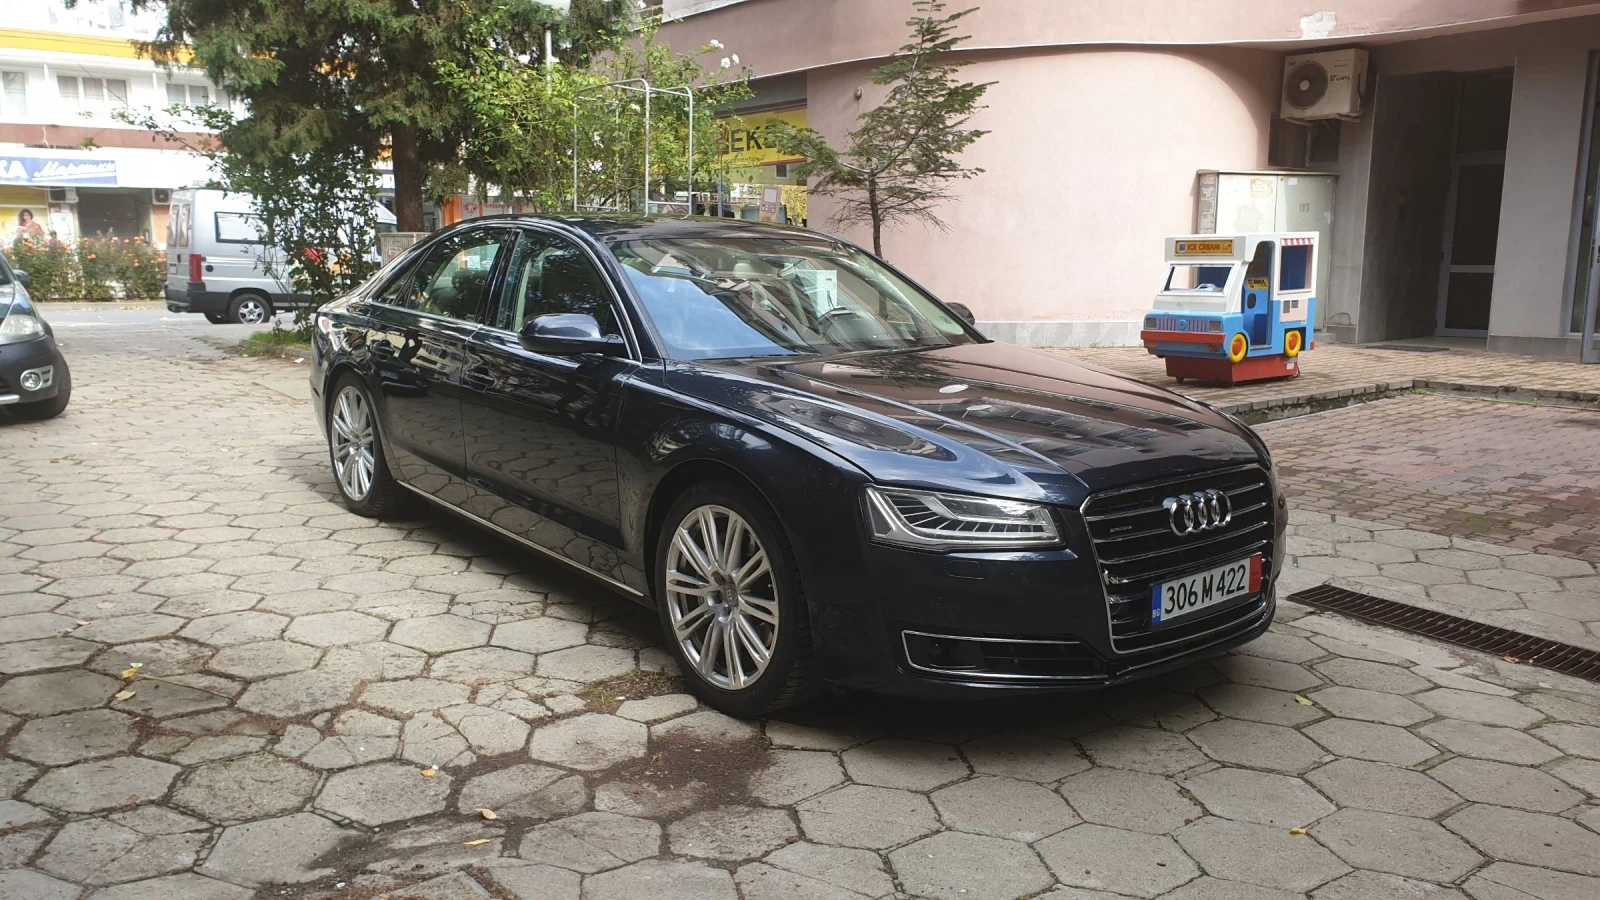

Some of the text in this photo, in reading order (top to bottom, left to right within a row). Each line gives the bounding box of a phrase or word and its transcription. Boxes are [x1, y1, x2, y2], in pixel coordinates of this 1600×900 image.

[1188, 243, 1197, 251] ICE
[1199, 243, 1220, 251] CREAM
[1152, 608, 1160, 618] BG
